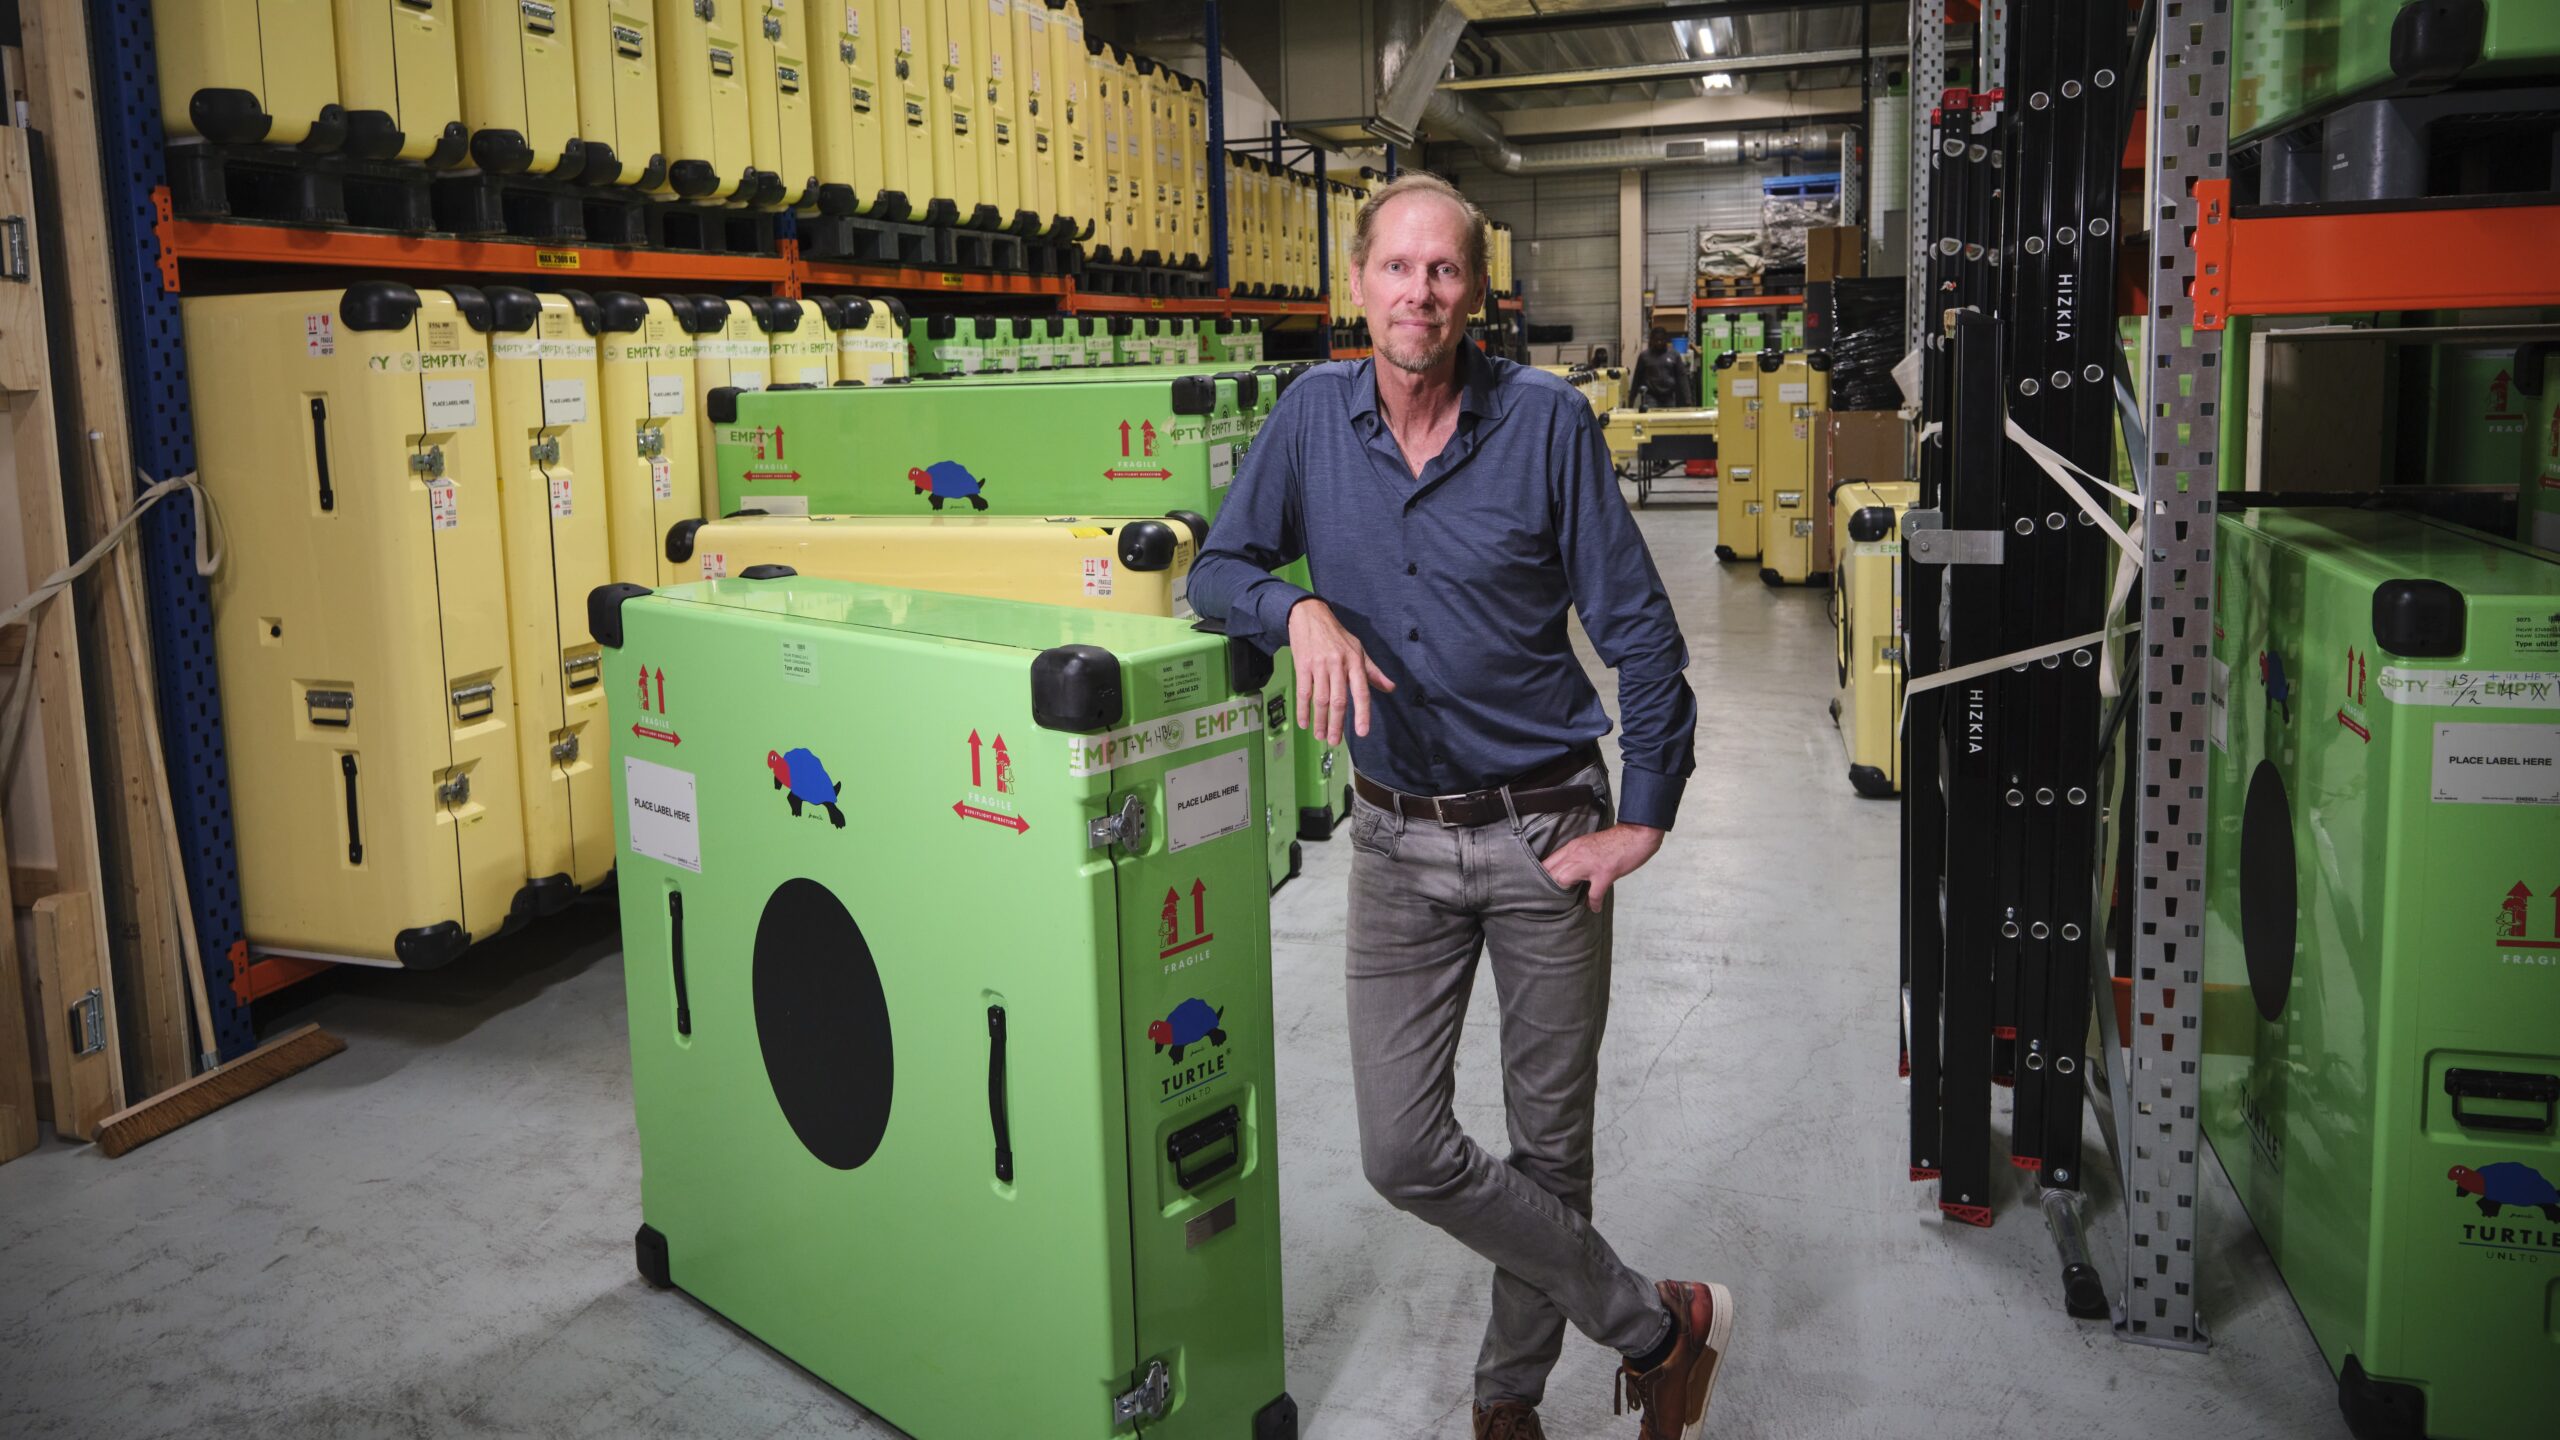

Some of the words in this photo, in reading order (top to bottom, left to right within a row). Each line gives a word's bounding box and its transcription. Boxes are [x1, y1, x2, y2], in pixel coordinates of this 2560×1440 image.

[2055, 274, 2073, 342] HIZKIA
[627, 346, 660, 360] EMPTY
[810, 342, 834, 353] EMPTY
[421, 353, 467, 369] EMPTY
[730, 431, 777, 443] EMPTY
[1211, 421, 1232, 437] EMPTY
[2515, 640, 2533, 648] Type
[2484, 681, 2553, 697] EMPTY
[1195, 703, 1263, 739] EMPTY
[1968, 689, 1984, 754] HIZKIA
[1070, 731, 1146, 770] EMPTY
[2449, 756, 2484, 765] PLACE
[2486, 757, 2521, 766] LABEL
[2523, 757, 2553, 767] HERE
[967, 792, 1013, 811] FRAGILE
[1177, 797, 1200, 811] PLACE
[1200, 790, 1222, 804] LABEL
[1222, 784, 1240, 797] HERE
[634, 797, 654, 812] PLACE
[653, 804, 674, 818] LABEL
[673, 809, 691, 823] HERE
[964, 808, 992, 820] RIDE/FLIGHT
[993, 815, 1017, 826] DIRECTION
[1164, 949, 1211, 976] FRAGILE
[2502, 954, 2556, 965] FRAGI
[1161, 1054, 1226, 1096] TURTLE
[1178, 1085, 1212, 1108] UNLTD
[2241, 1082, 2278, 1161] TURTLE
[2463, 1224, 2560, 1248] TURTLE
[2486, 1251, 2539, 1263] UNLTD
